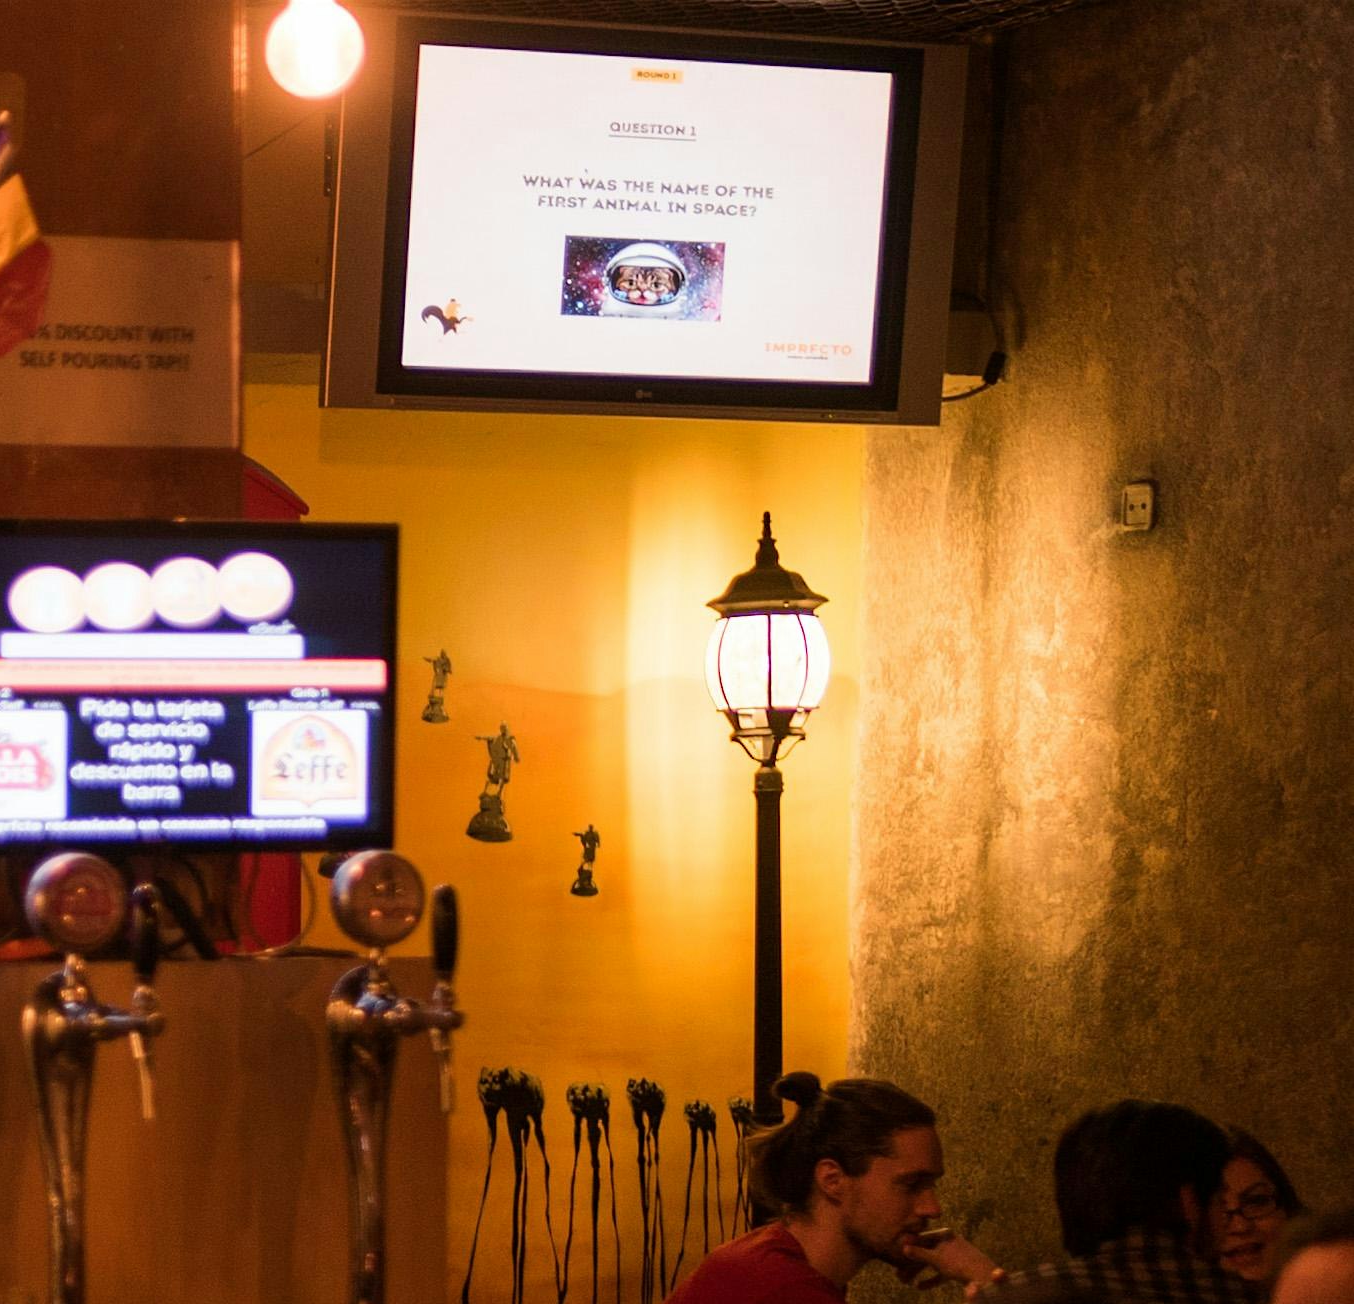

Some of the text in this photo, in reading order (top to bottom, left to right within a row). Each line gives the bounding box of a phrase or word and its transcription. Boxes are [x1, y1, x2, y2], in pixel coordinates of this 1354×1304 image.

[636, 71, 670, 80] ROUND
[610, 121, 698, 137] QUESTION 1
[522, 174, 775, 200] WHAT WAS THE NAME OF THE
[537, 194, 758, 218] FIRST ANIMAL IN SPACE?
[80, 698, 131, 718] Pide
[131, 699, 156, 718] tu
[156, 699, 226, 722] tarjeta
[95, 720, 211, 739] de servicio
[178, 743, 196, 763] y
[69, 760, 235, 781] descuento en la
[270, 752, 348, 782] Leffe
